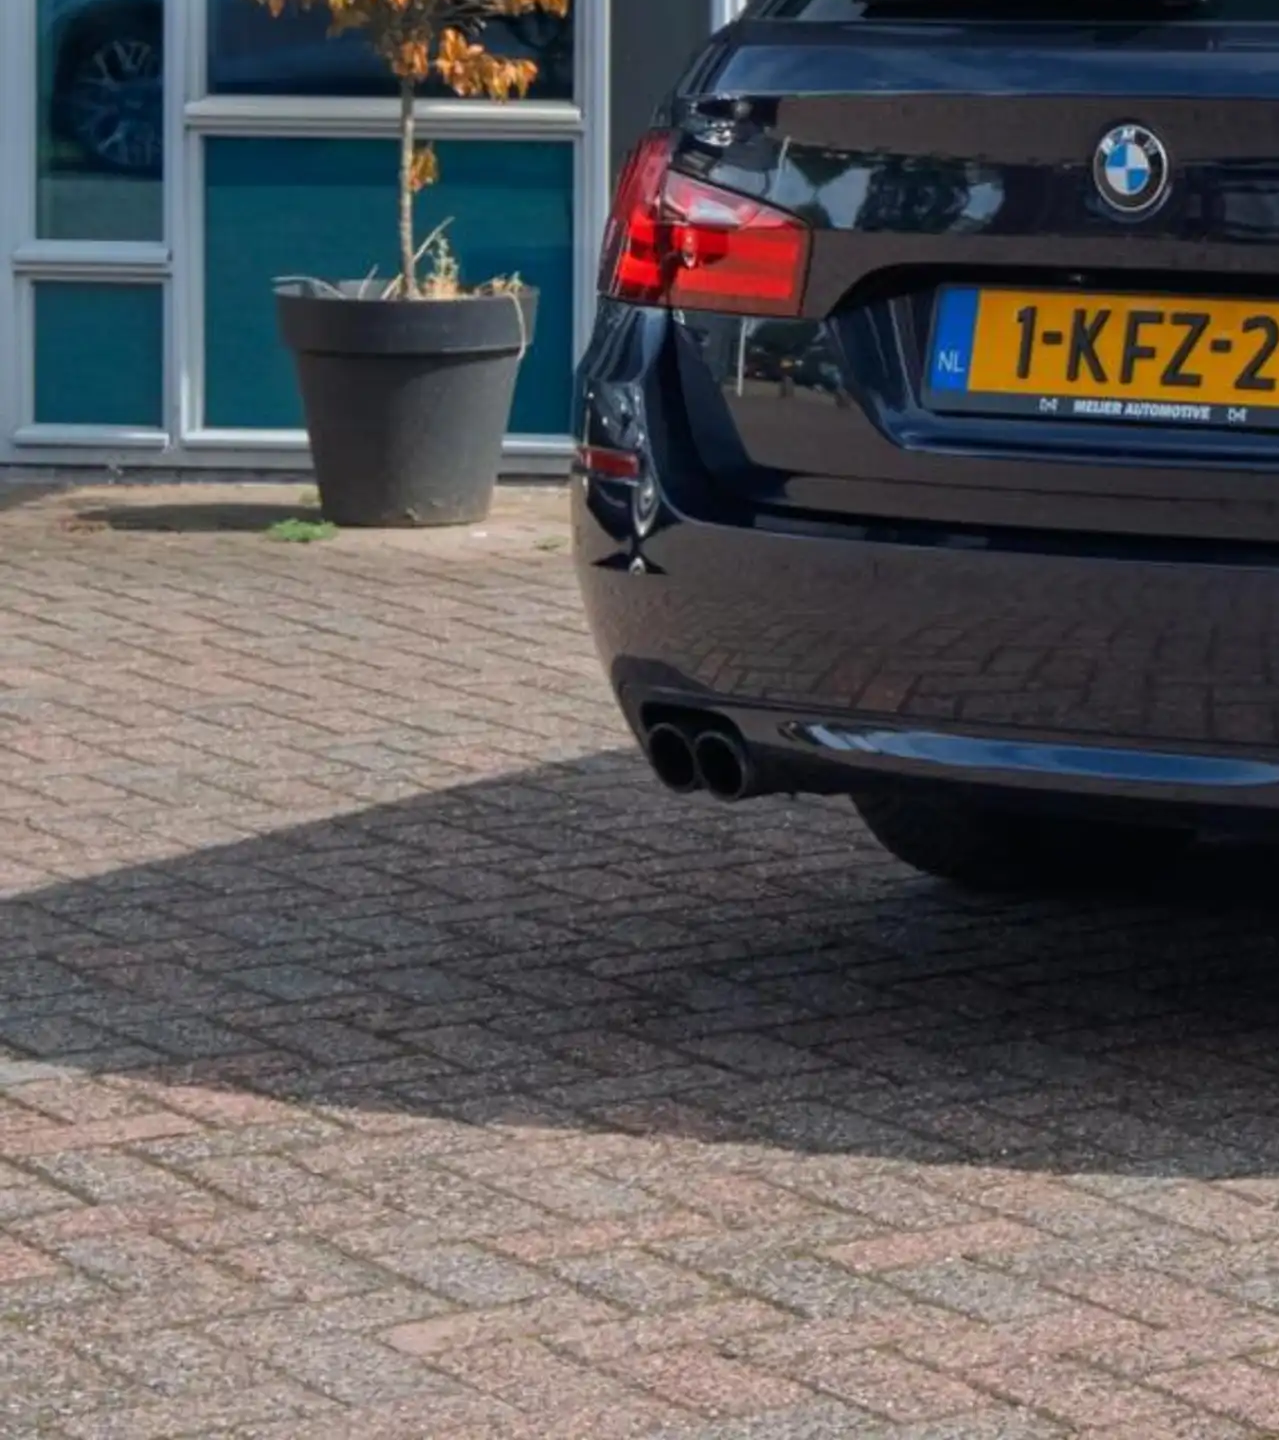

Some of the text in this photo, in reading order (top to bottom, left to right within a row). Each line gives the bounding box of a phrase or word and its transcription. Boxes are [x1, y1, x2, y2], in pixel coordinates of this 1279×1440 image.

[938, 349, 965, 373] NL
[1073, 399, 1122, 416] MEIJER
[1123, 402, 1211, 421] AUTOMOTIVE
